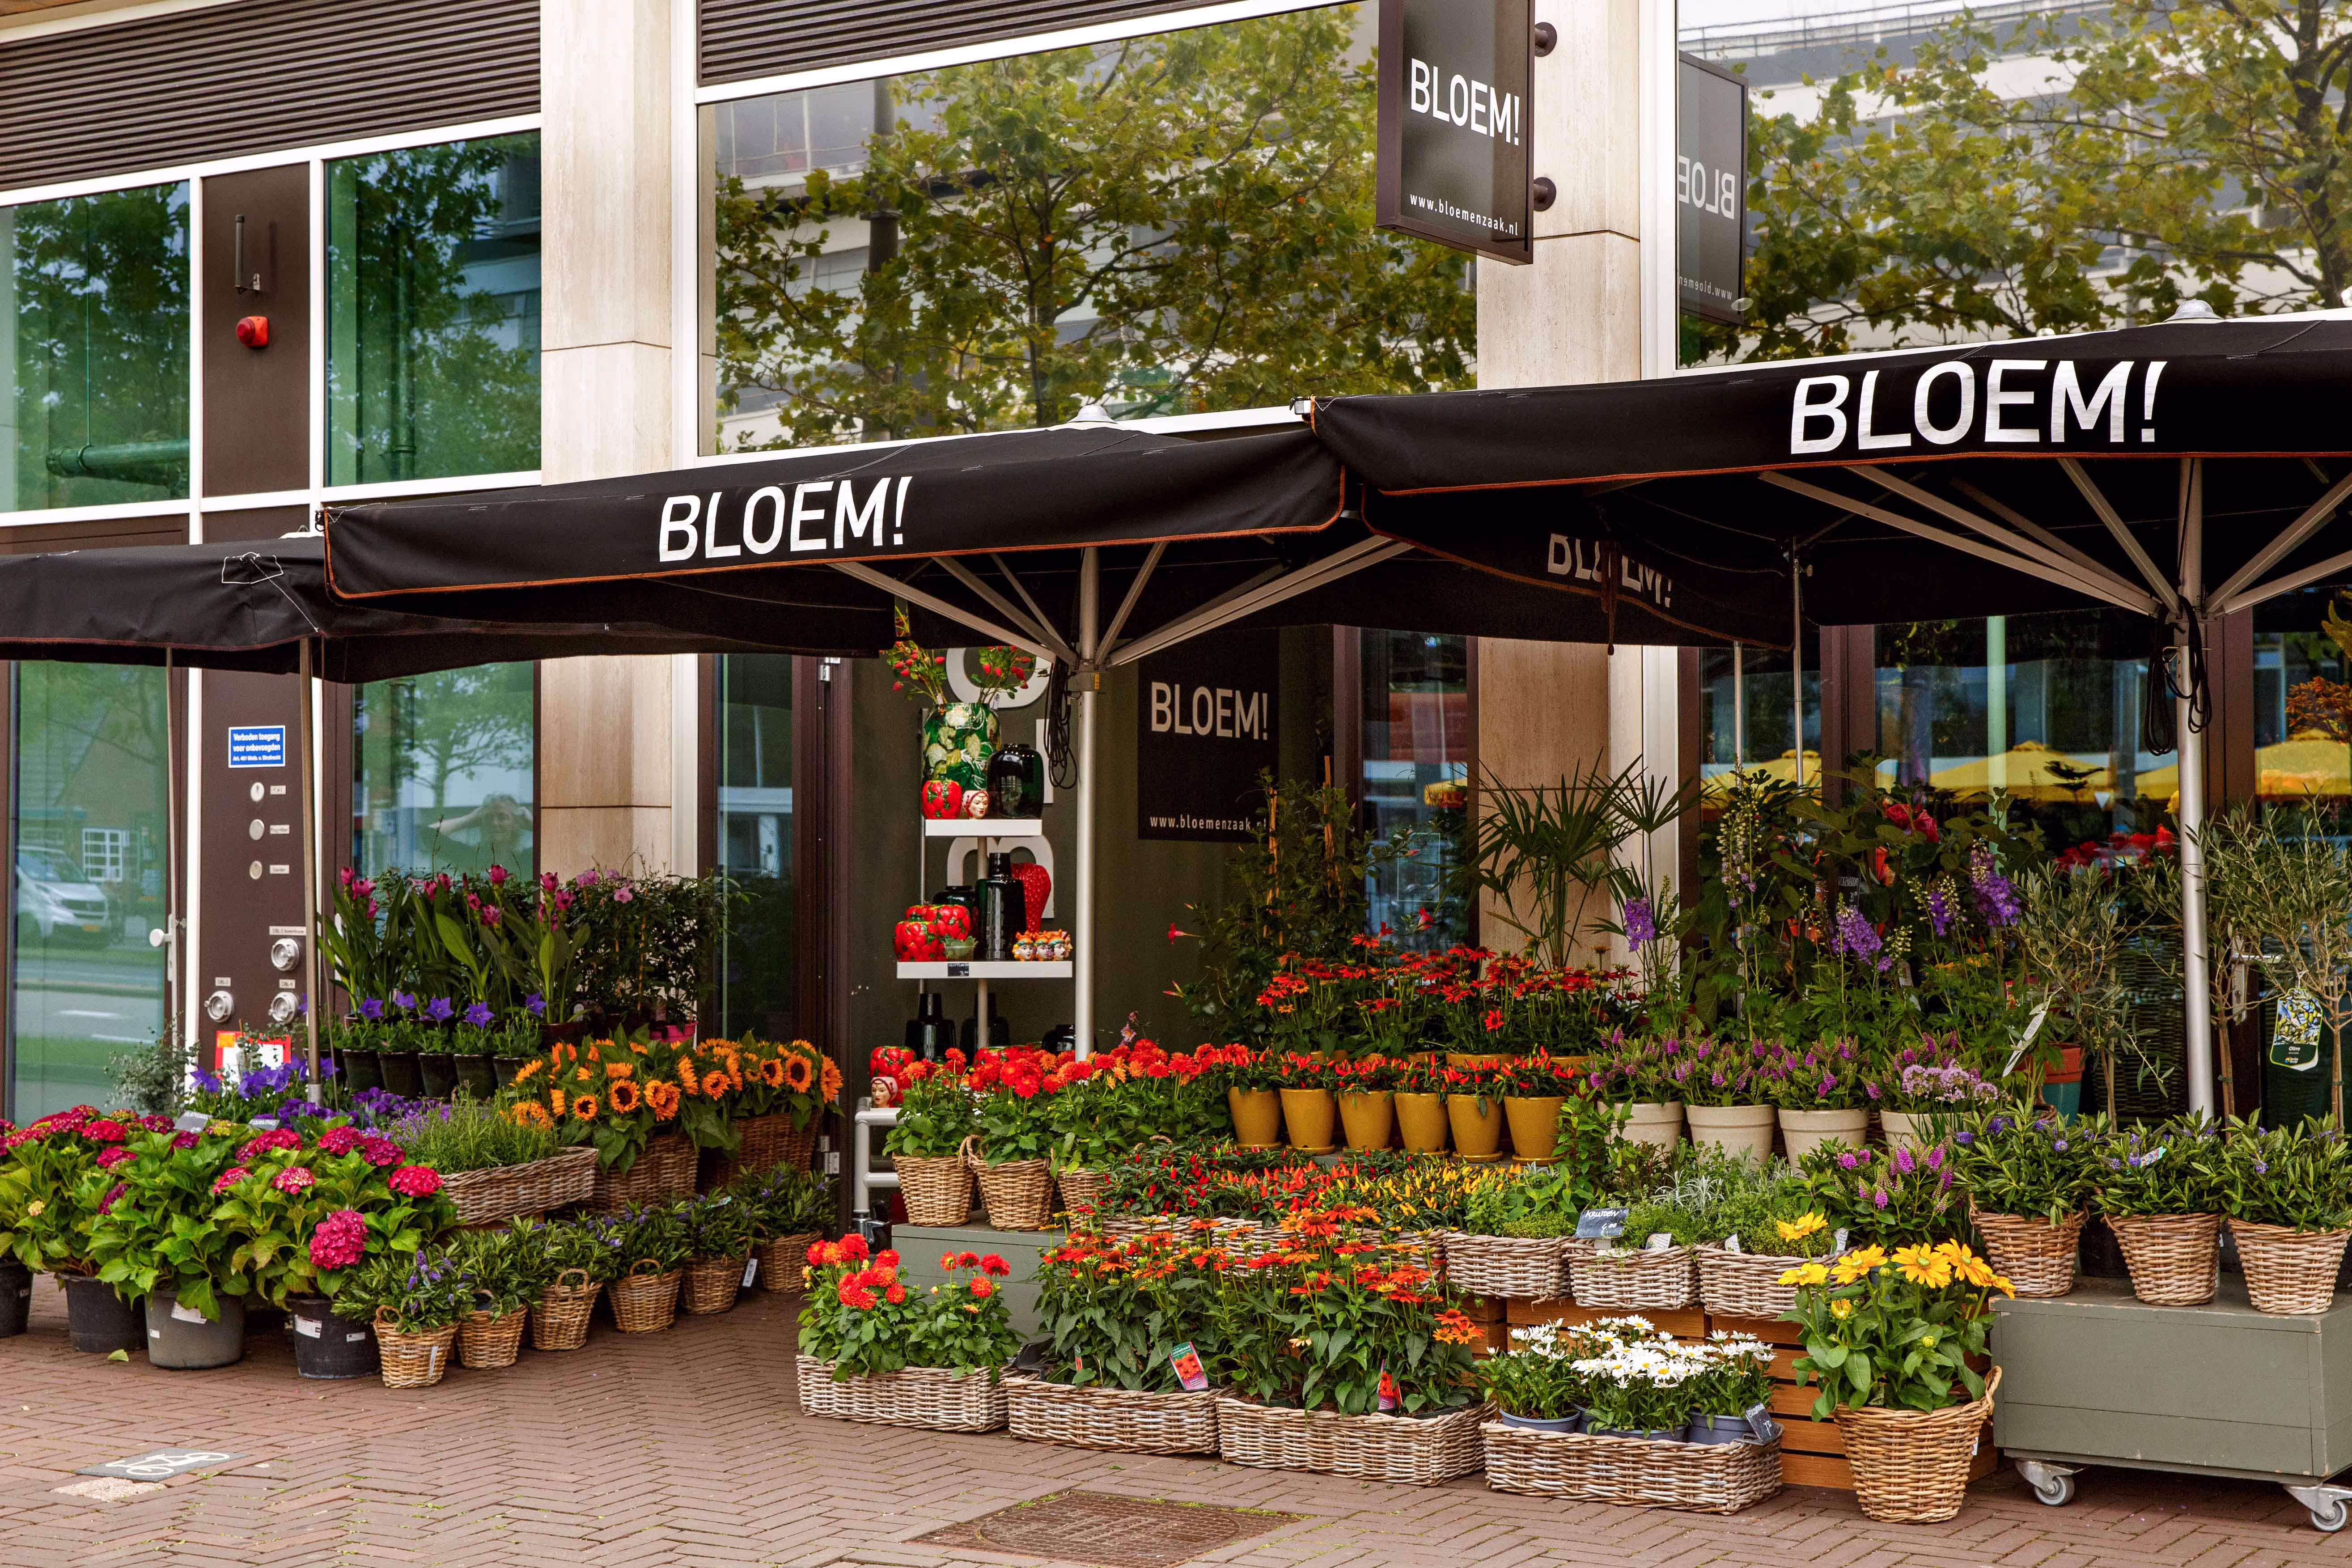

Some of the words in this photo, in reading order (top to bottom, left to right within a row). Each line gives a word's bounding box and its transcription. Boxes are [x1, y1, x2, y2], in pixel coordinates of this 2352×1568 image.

[1411, 58, 1520, 146] BLOEM!
[1410, 193, 1518, 236] www.bloemenzaak.nl
[1790, 359, 2168, 454] BLOEM!
[659, 476, 913, 562] BLOEM!
[1151, 681, 1268, 741] BLOEM!
[233, 733, 258, 742] Verboden
[258, 733, 280, 742] toegang
[246, 743, 281, 753] onbevoegden
[1585, 1209, 1620, 1218] KRUIDEN
